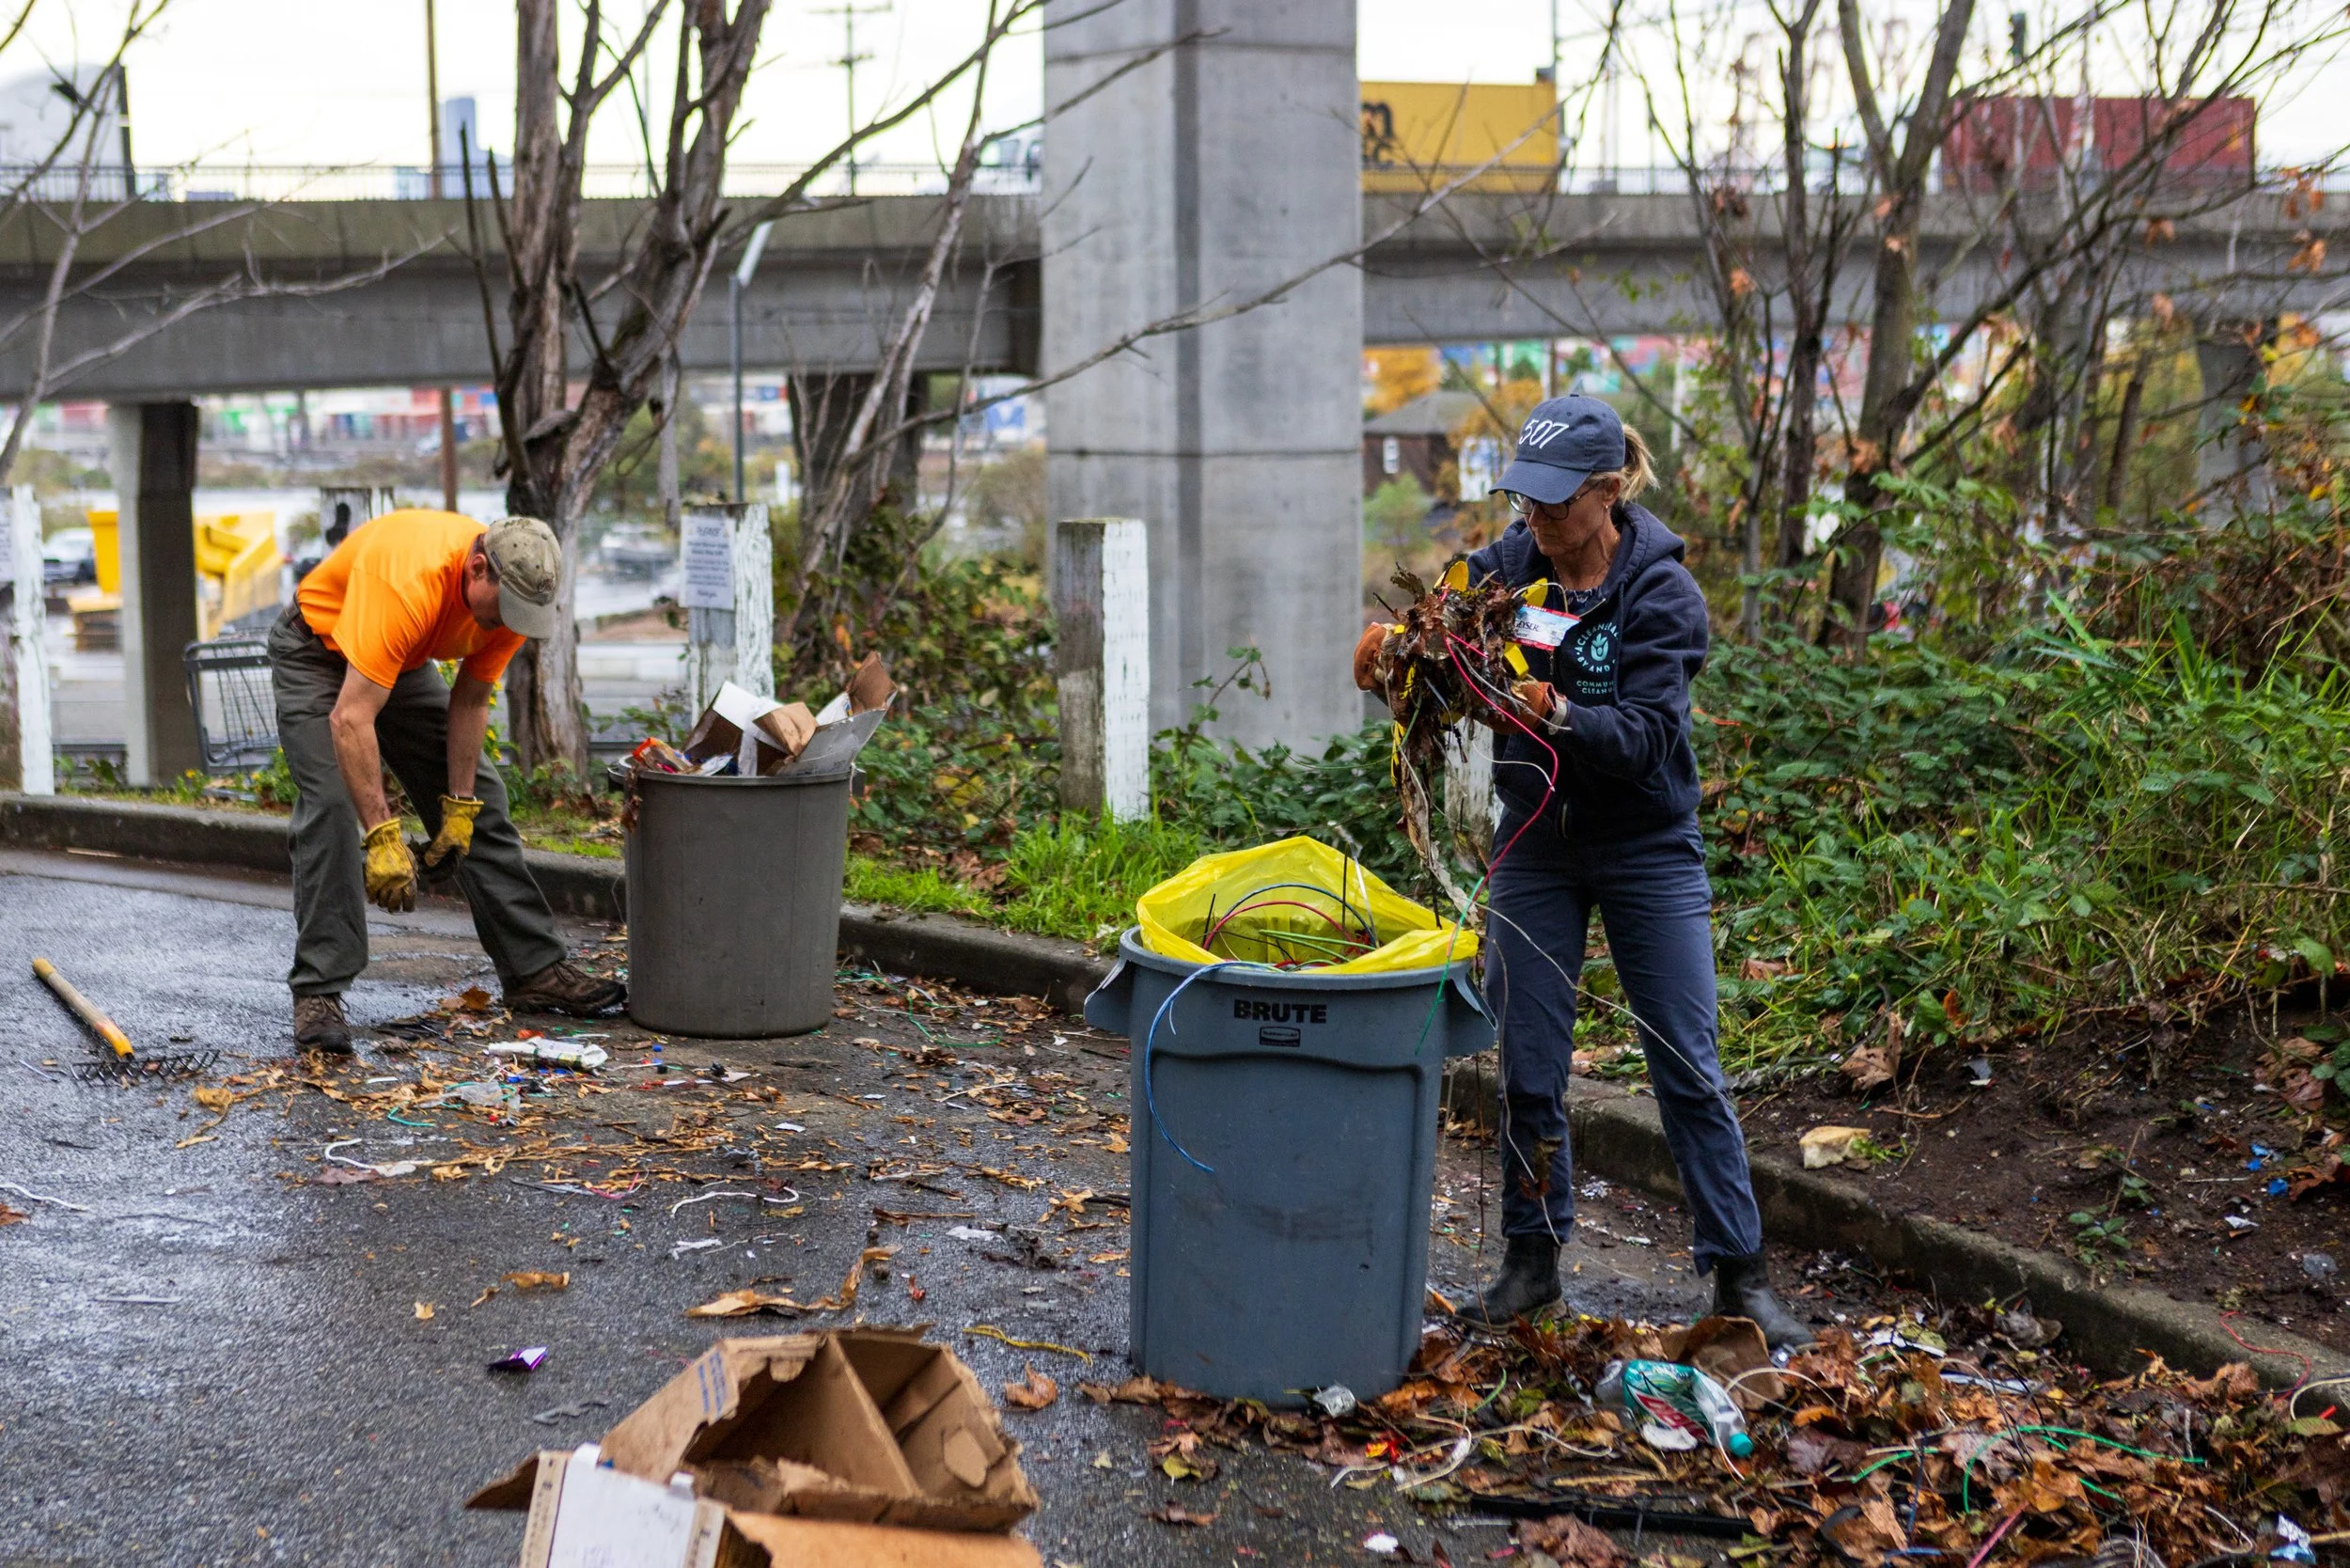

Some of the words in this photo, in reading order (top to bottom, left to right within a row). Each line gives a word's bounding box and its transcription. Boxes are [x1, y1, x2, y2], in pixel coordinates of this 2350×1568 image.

[1518, 418, 1570, 449] 507
[1589, 665, 1610, 673] AND
[1233, 998, 1327, 1024] BRUTE
